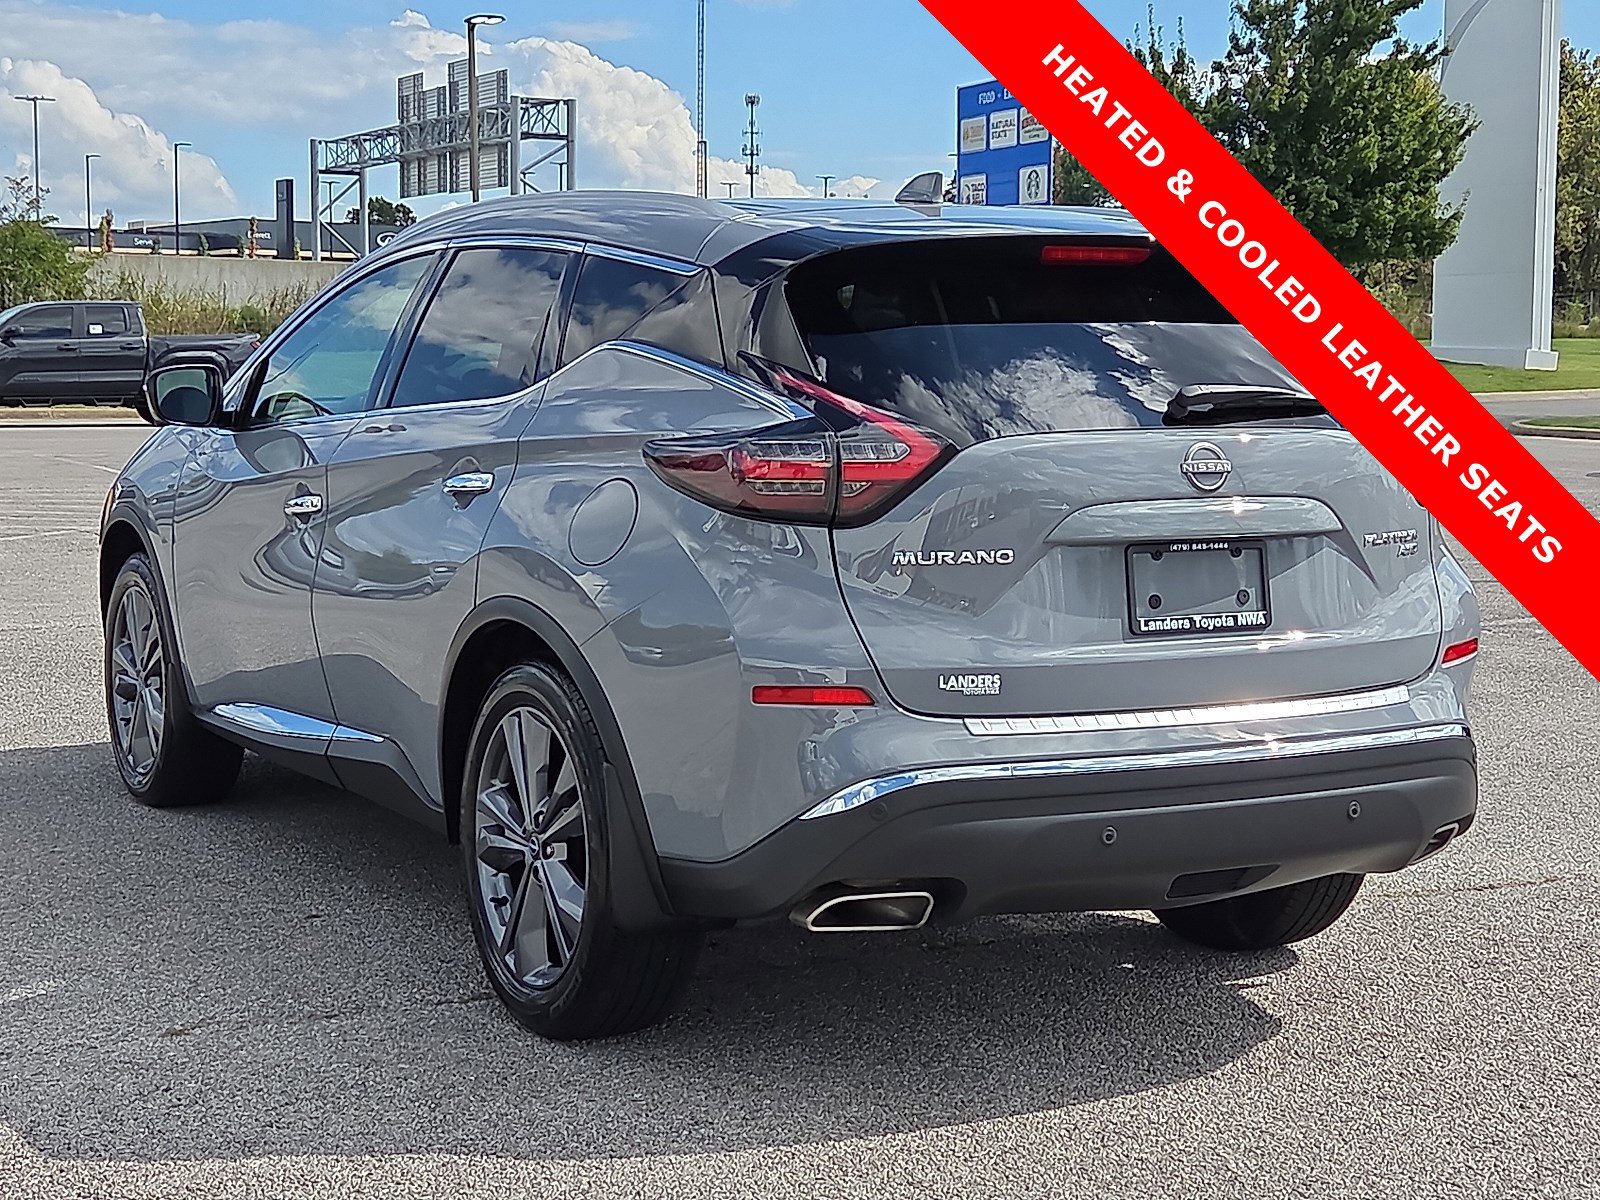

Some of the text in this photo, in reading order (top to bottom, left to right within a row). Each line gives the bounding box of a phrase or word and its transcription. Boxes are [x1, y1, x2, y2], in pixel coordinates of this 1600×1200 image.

[991, 118, 1016, 130] NATURAL
[991, 130, 1008, 140] STATE
[1182, 462, 1232, 472] NISSAN
[891, 549, 1015, 566] MURANO
[1140, 612, 1266, 631] Landers Toyota NWA
[939, 674, 1001, 690] LANDERS
